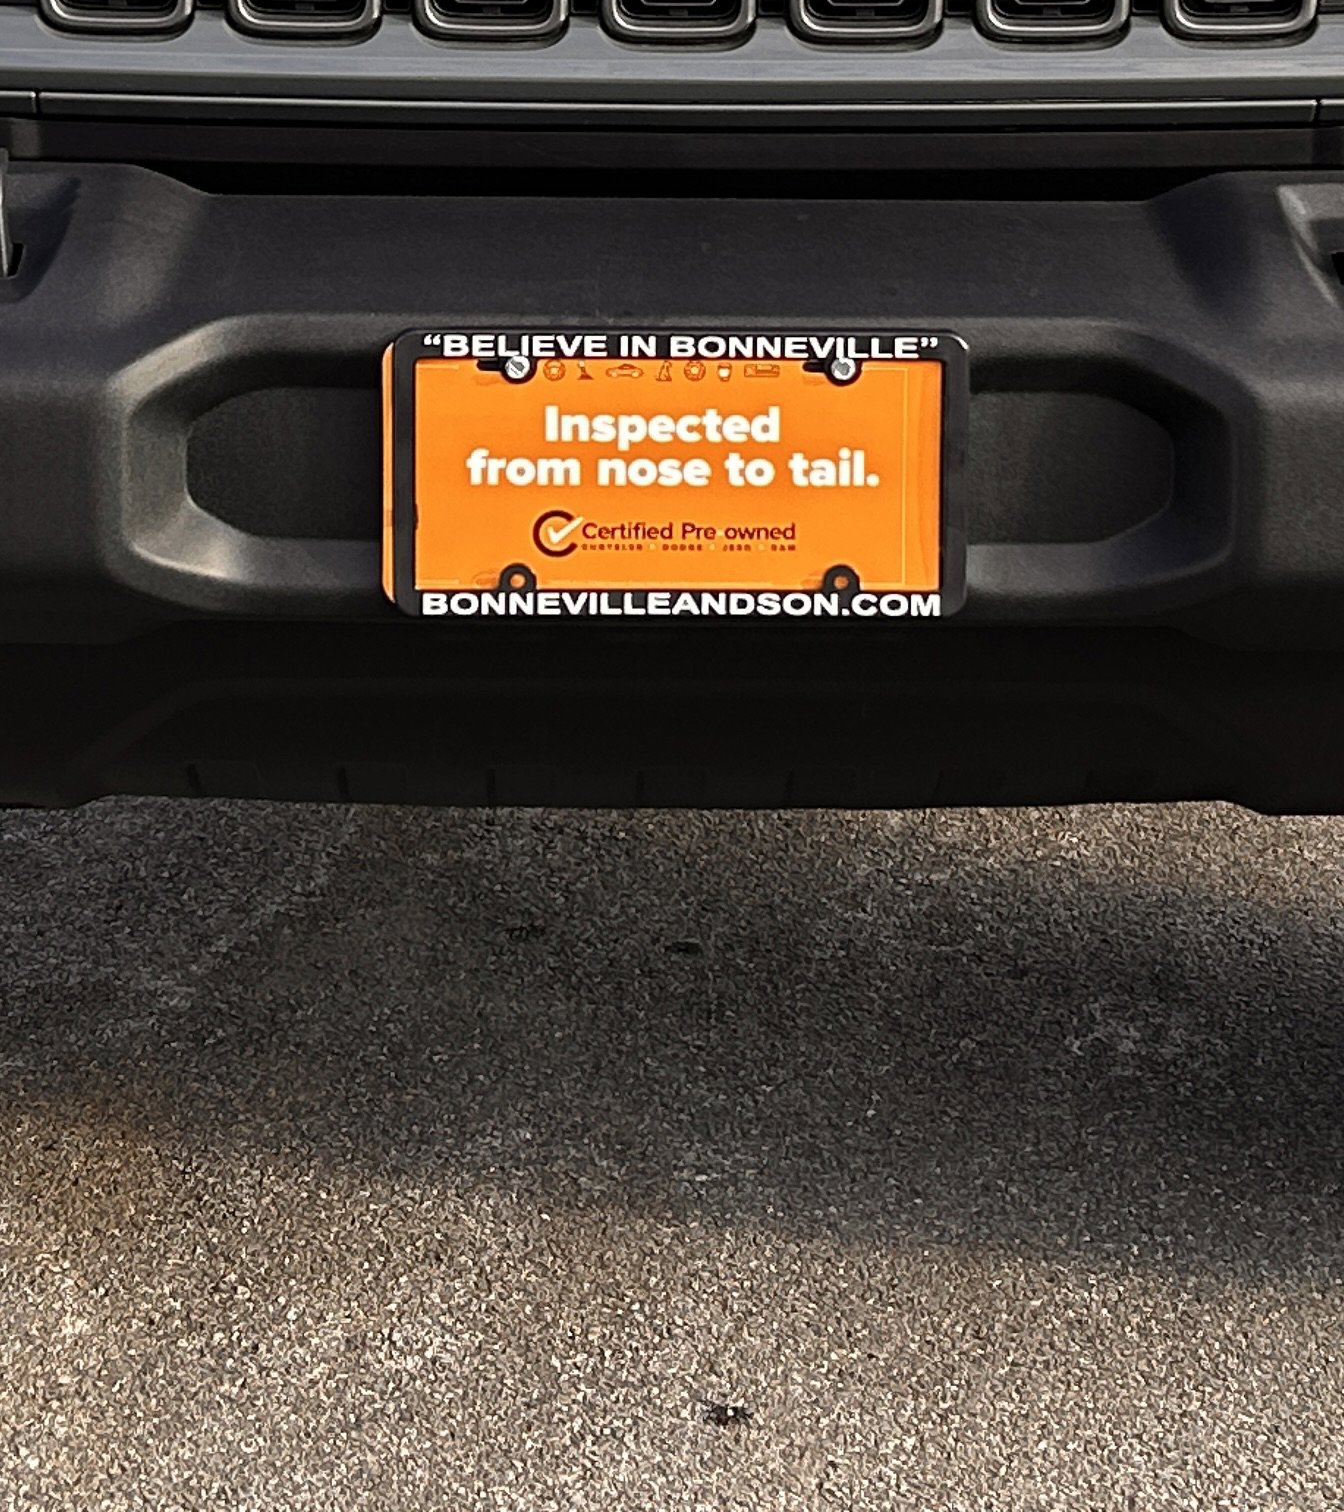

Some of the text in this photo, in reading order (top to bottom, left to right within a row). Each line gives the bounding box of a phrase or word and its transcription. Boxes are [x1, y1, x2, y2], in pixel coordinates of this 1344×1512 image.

[619, 335, 657, 358] IN
[544, 405, 781, 451] Inspected
[466, 447, 881, 487] from nose to tail.
[581, 521, 674, 541] Certified
[421, 591, 942, 617] BONNEVILLEANDSON.COM
